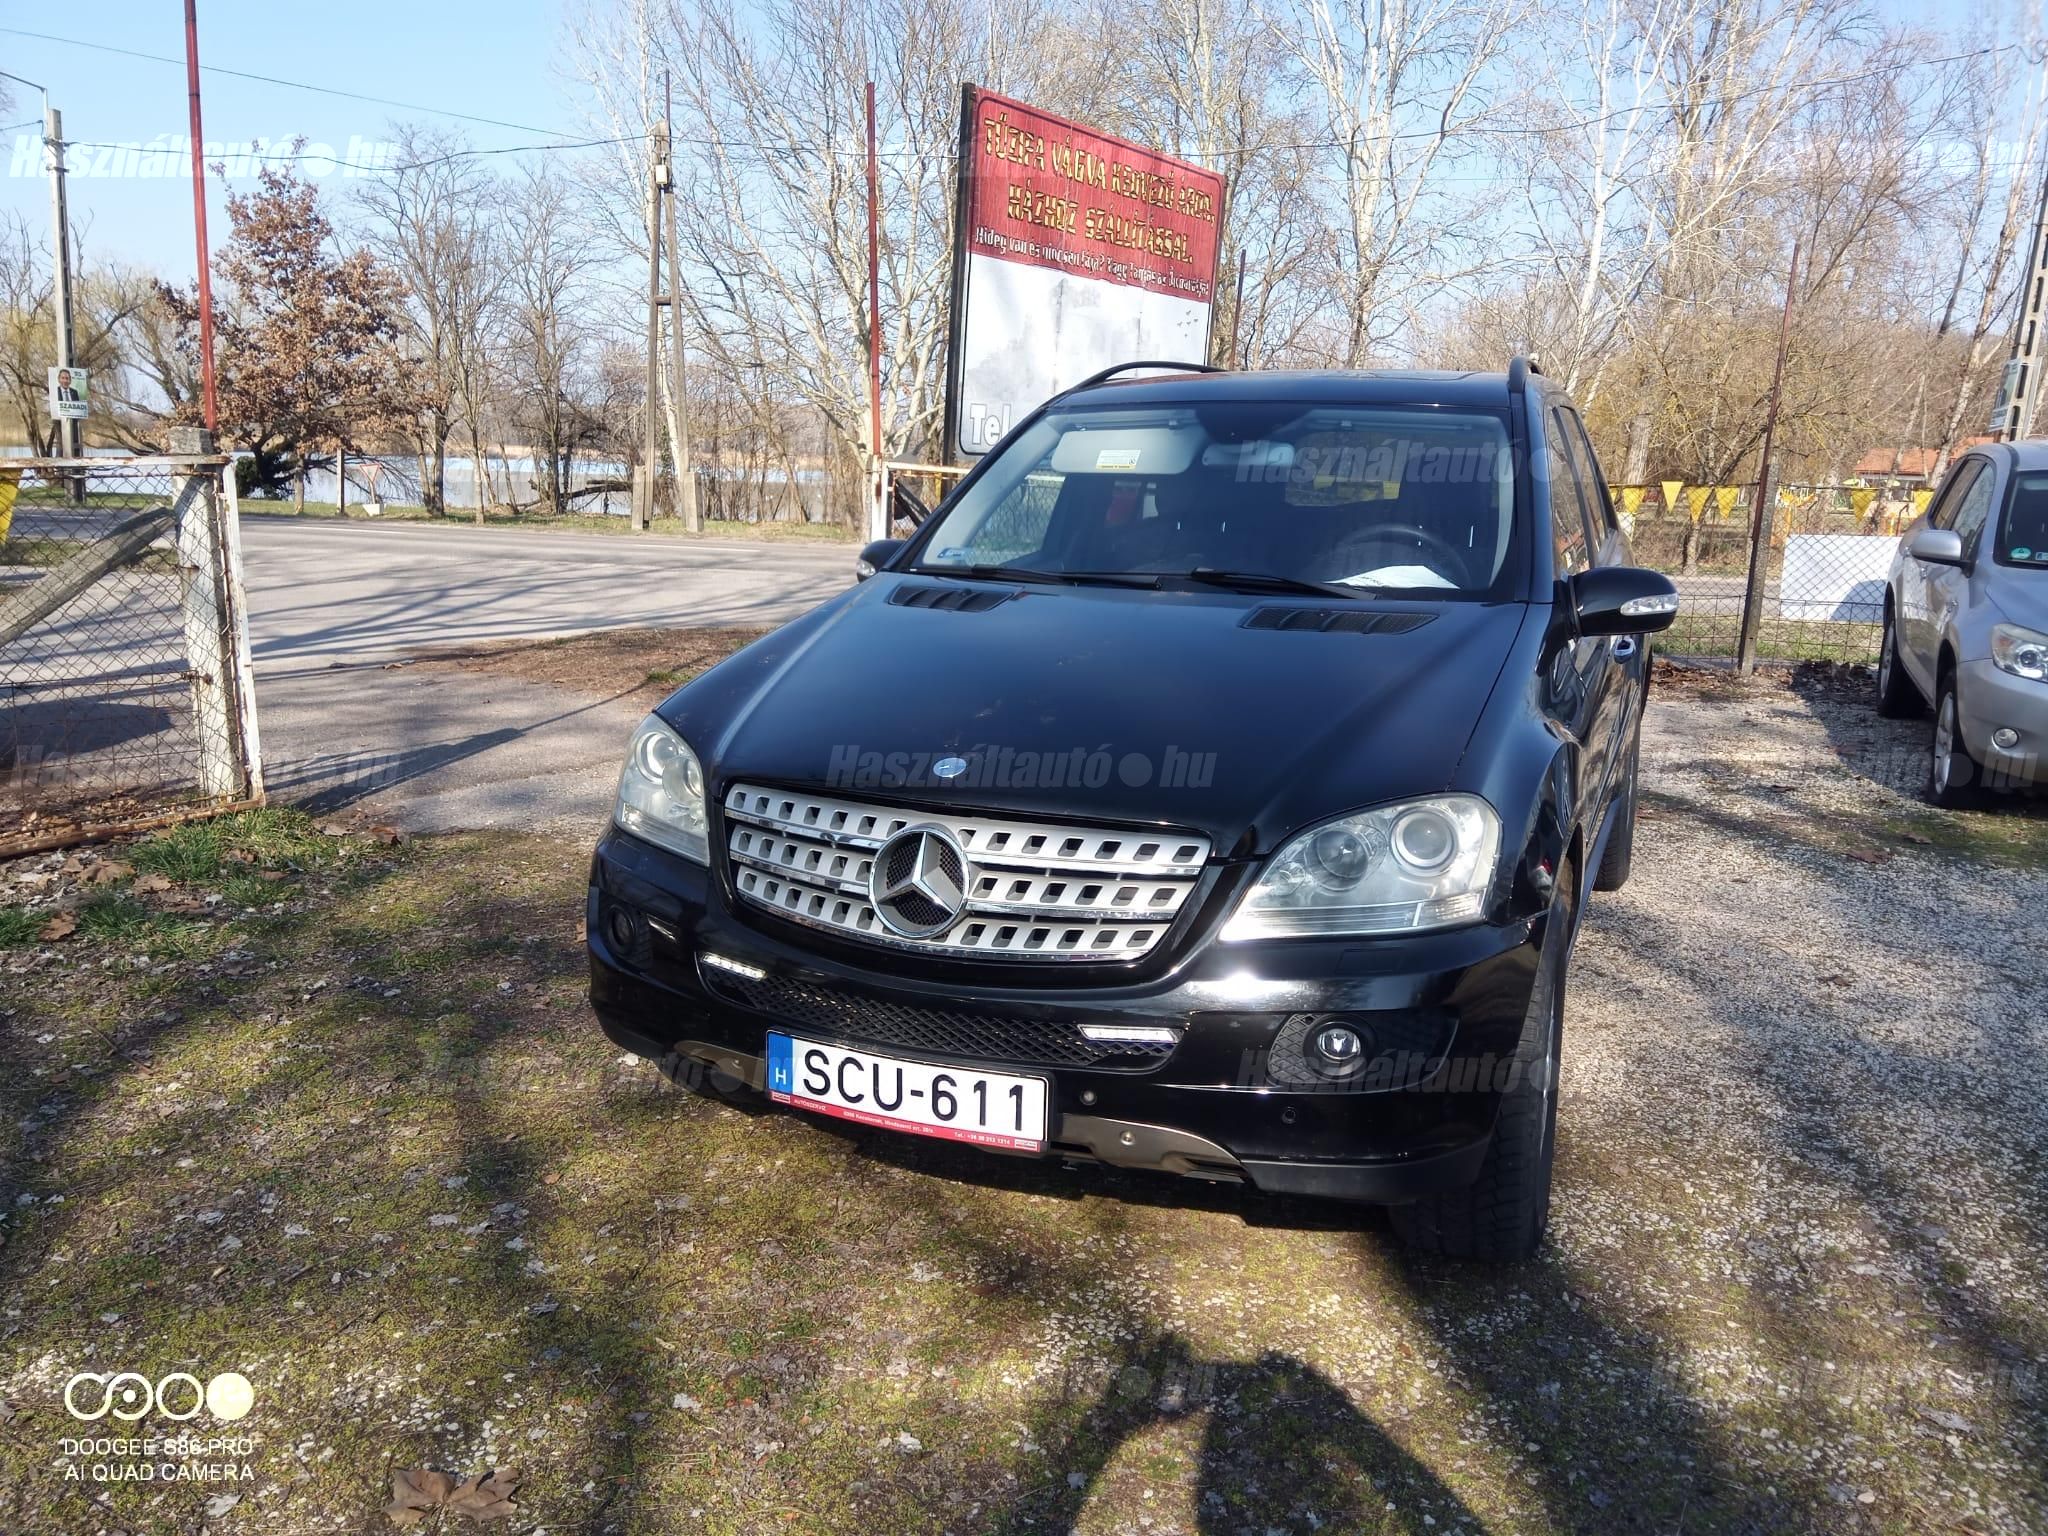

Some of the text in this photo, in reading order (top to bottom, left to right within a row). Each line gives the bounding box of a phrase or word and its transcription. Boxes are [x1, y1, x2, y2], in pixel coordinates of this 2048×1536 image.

[1052, 135, 1107, 190] VÁGVA
[976, 226, 1007, 255] Hideg
[1009, 237, 1027, 254] van
[775, 1067, 787, 1085] H
[803, 1049, 1023, 1131] SCU-611
